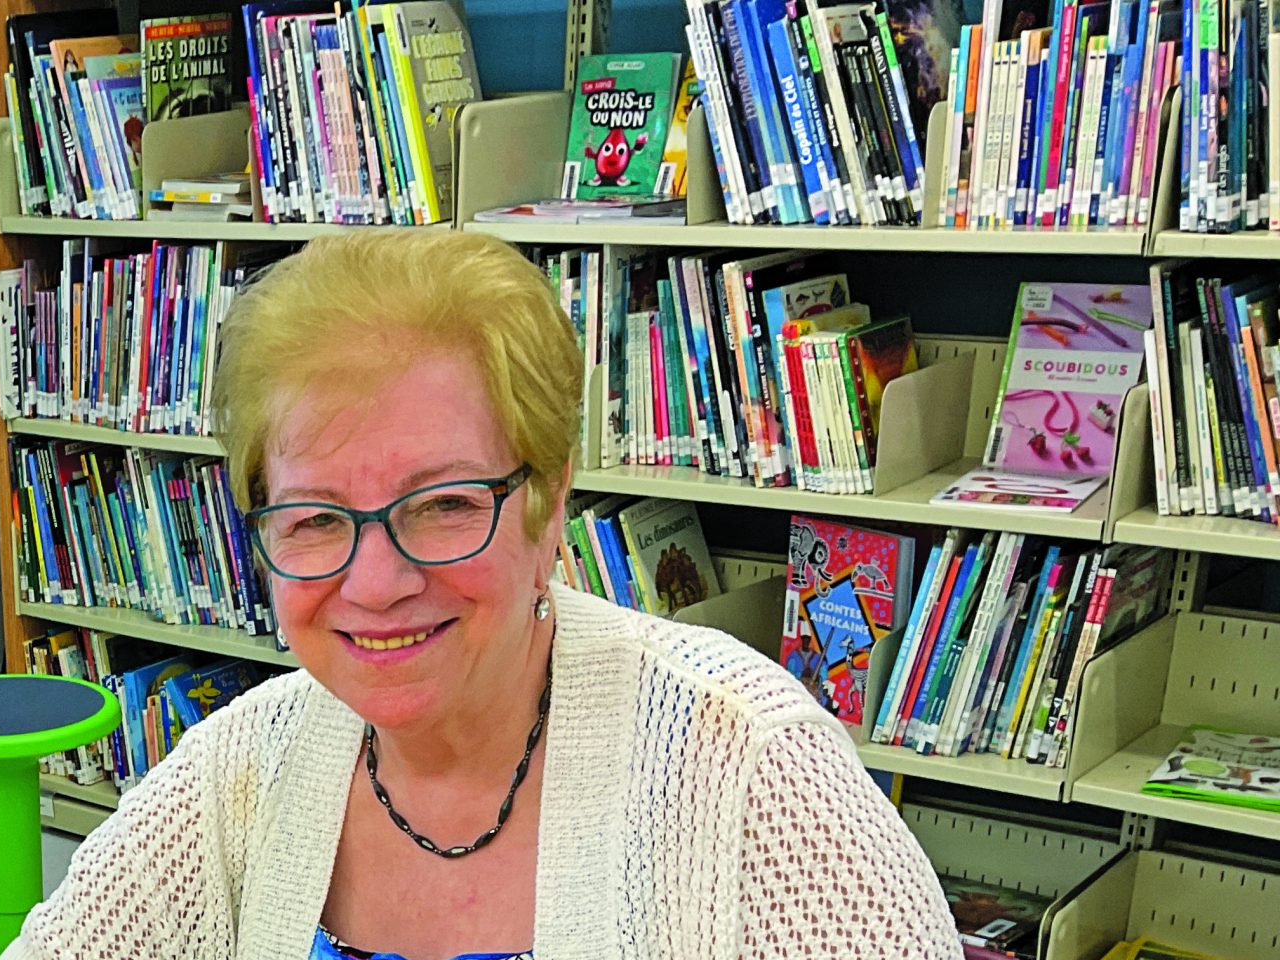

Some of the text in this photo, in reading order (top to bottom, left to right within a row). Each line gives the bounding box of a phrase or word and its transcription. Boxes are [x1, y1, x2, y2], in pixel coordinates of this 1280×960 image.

[150, 36, 227, 61] LES DROITS
[152, 59, 226, 82] DE L'ANIMAL
[587, 91, 653, 110] CROIS-LE
[278, 101, 289, 146] RELIGIONS
[593, 110, 645, 128] OU NON
[781, 75, 812, 164] Copain du Ciel
[1024, 360, 1128, 376] SCOUBIDOUS
[637, 516, 695, 550] Les dinosaures
[820, 601, 861, 619] CONTES
[810, 612, 869, 635] AFRICAINS
